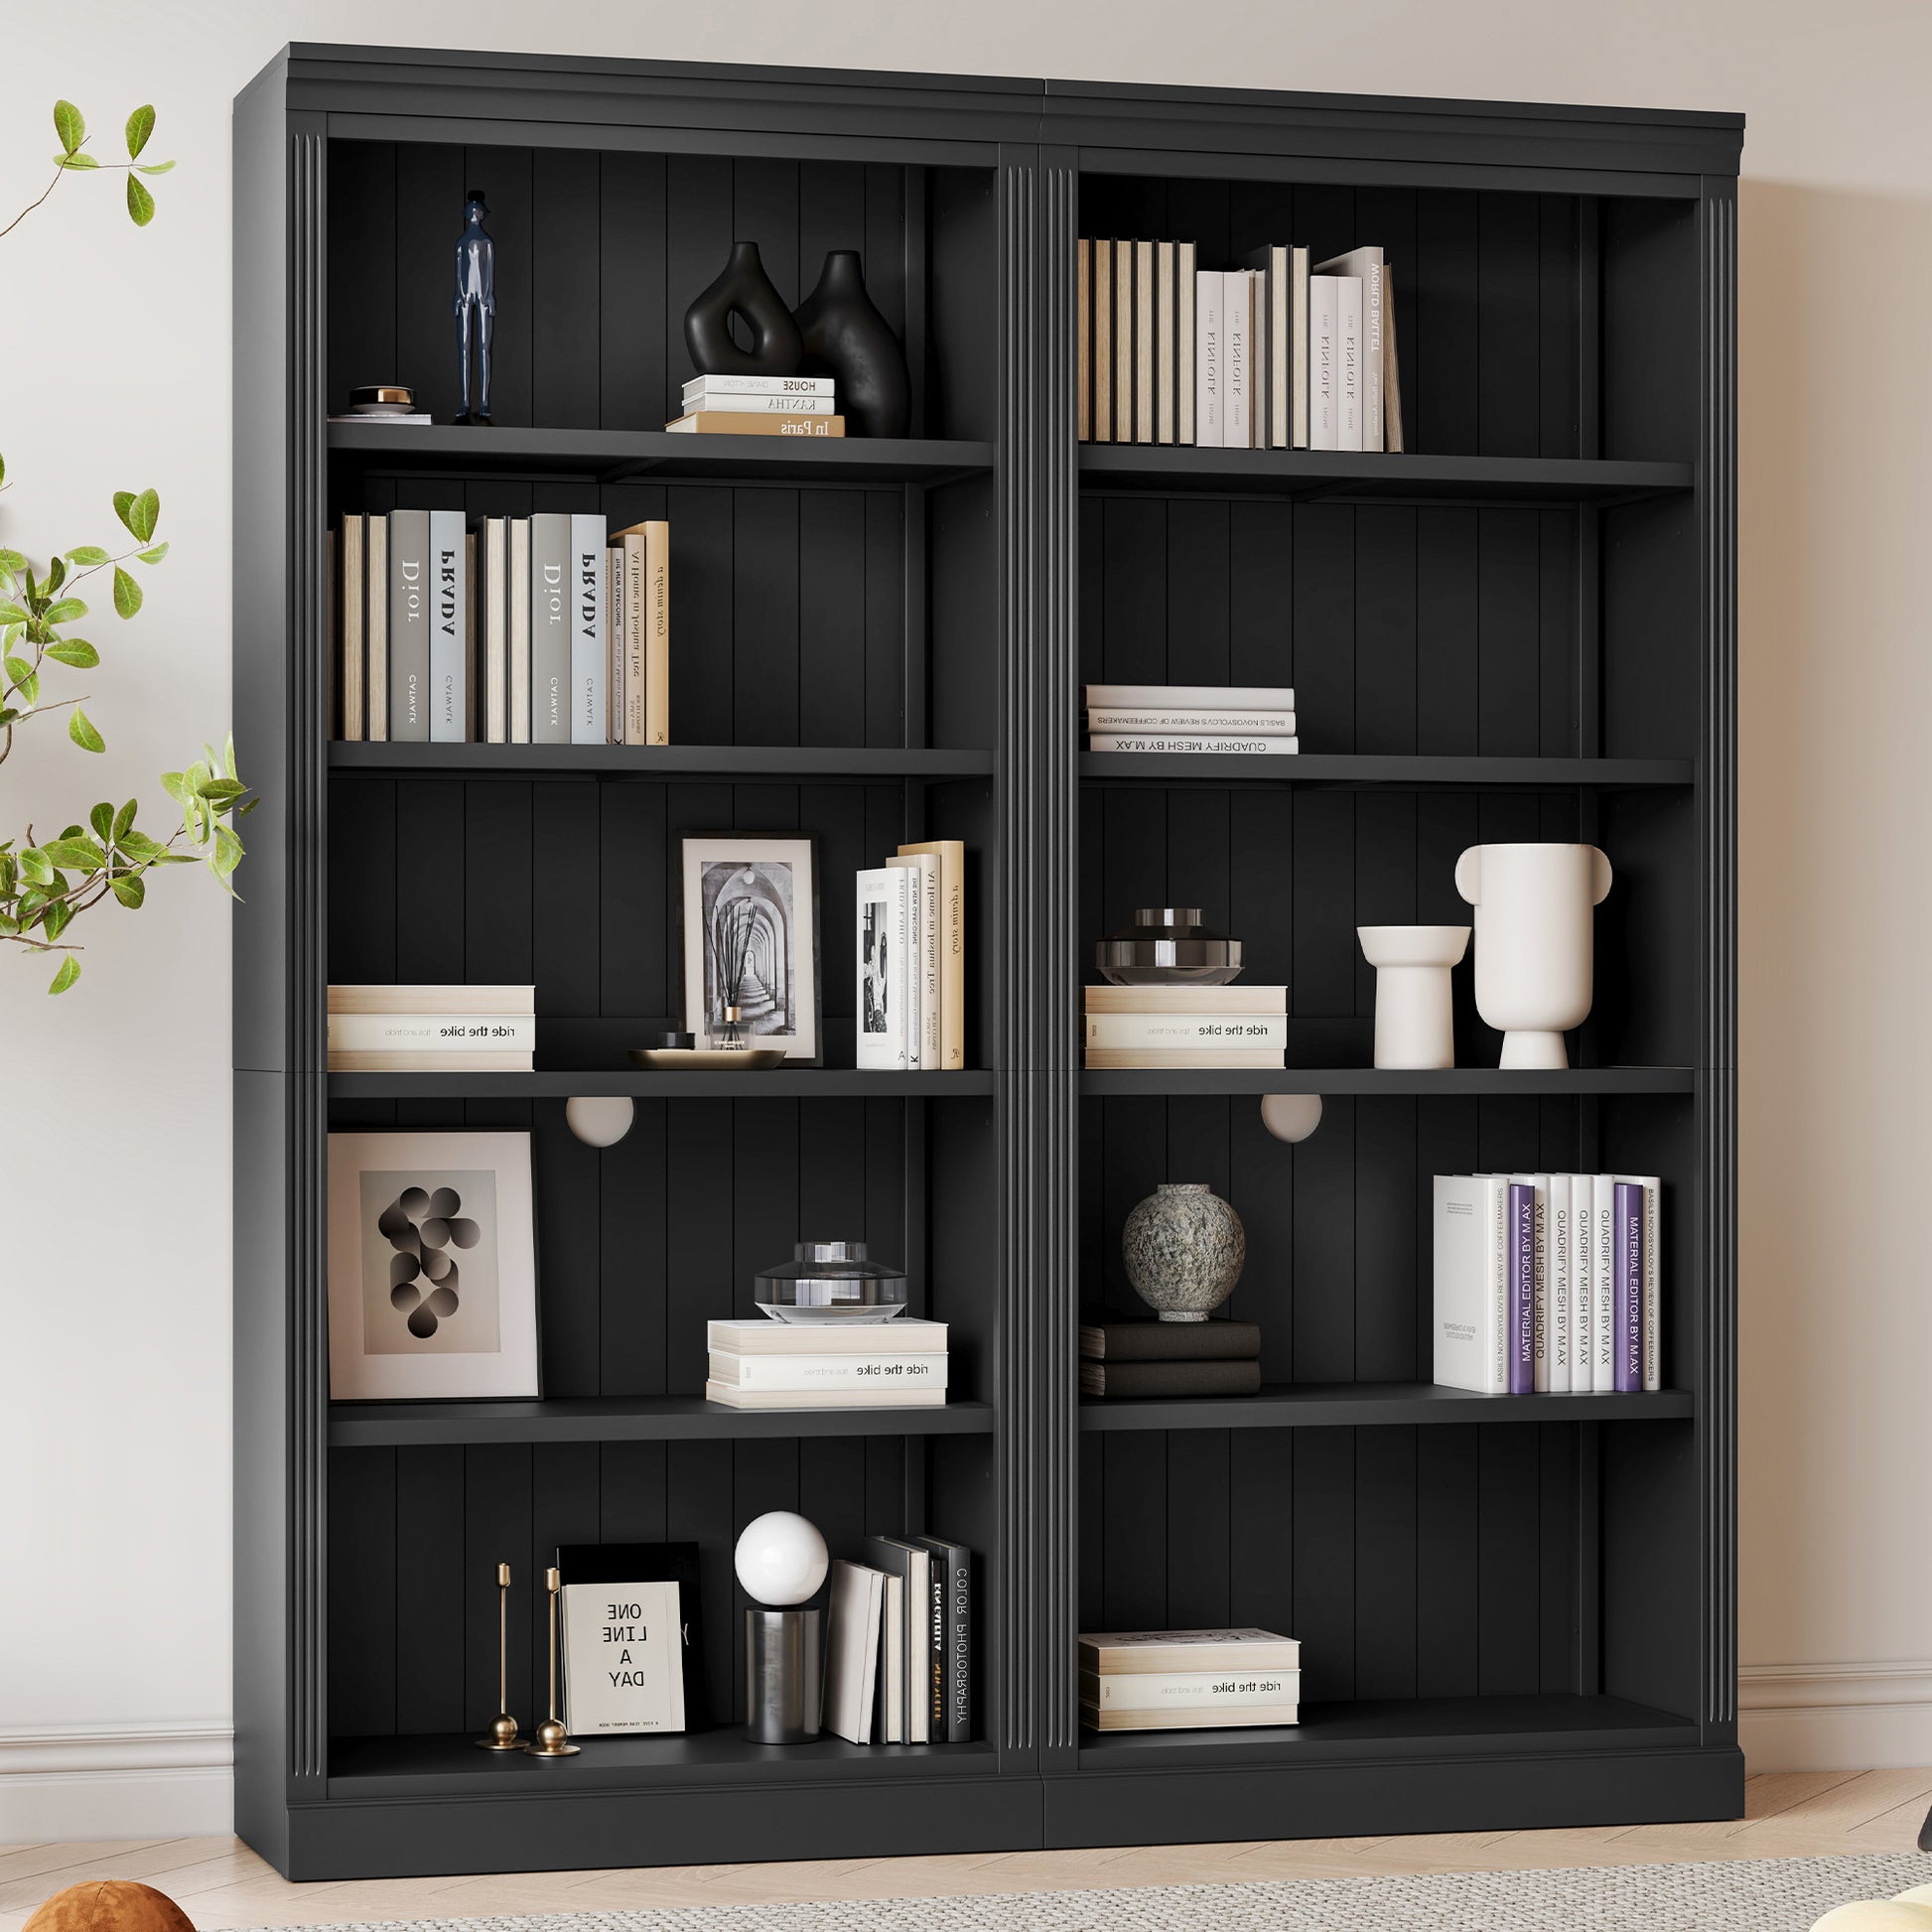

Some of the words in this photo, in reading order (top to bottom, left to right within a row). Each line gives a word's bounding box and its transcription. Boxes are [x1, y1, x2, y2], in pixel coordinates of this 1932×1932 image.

[1116, 741, 1145, 750] M.AX
[1169, 742, 1202, 751] MESH
[1206, 742, 1266, 752] QUADRIFY
[1522, 1203, 1531, 1233] M.AX
[1522, 1236, 1531, 1252] BY
[1536, 1236, 1544, 1253] BY
[1557, 1210, 1566, 1274] QUADRIFY
[1600, 1210, 1610, 1273] QUADRIFY
[1497, 1252, 1503, 1262] OF
[1522, 1255, 1531, 1300] EDITOR
[1536, 1257, 1545, 1291] MESH
[1601, 1277, 1610, 1311] MESH
[1648, 1309, 1654, 1318] OF
[1536, 1295, 1545, 1359] QUADRIFY
[1558, 1315, 1566, 1332] BY
[1580, 1315, 1587, 1331] BY
[1601, 1315, 1610, 1331] BY
[1522, 1303, 1531, 1361] MATERIAL
[1630, 1326, 1638, 1341] BY
[1601, 1335, 1610, 1365] M.AX
